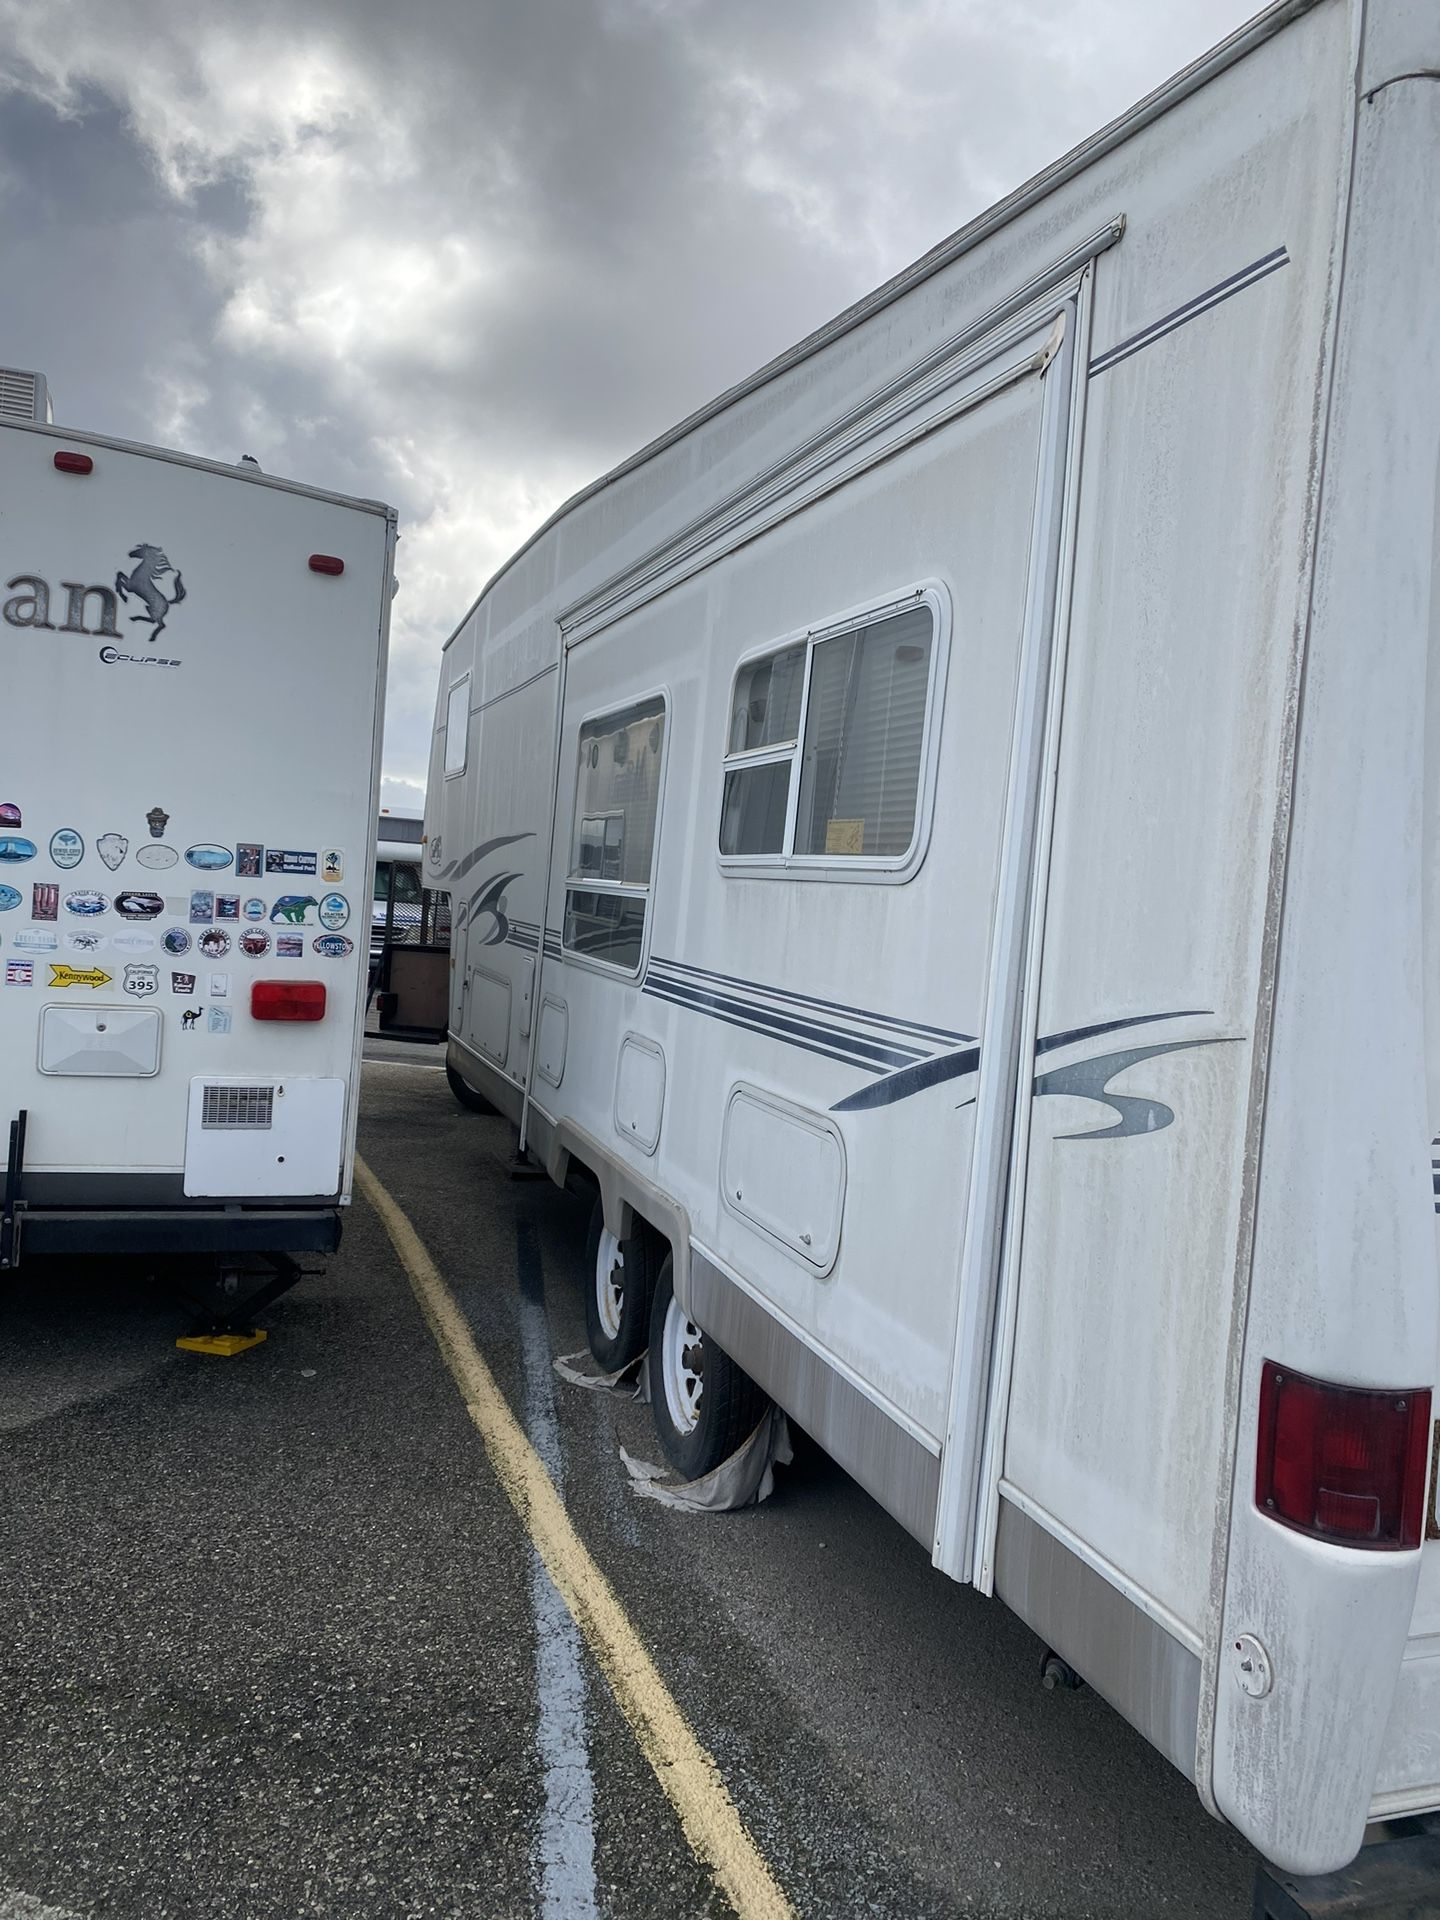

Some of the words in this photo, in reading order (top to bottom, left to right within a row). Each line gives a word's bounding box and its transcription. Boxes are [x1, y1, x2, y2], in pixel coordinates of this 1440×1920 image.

[3, 575, 124, 639] an
[60, 970, 104, 982] Kennywood
[128, 980, 154, 991] 395
